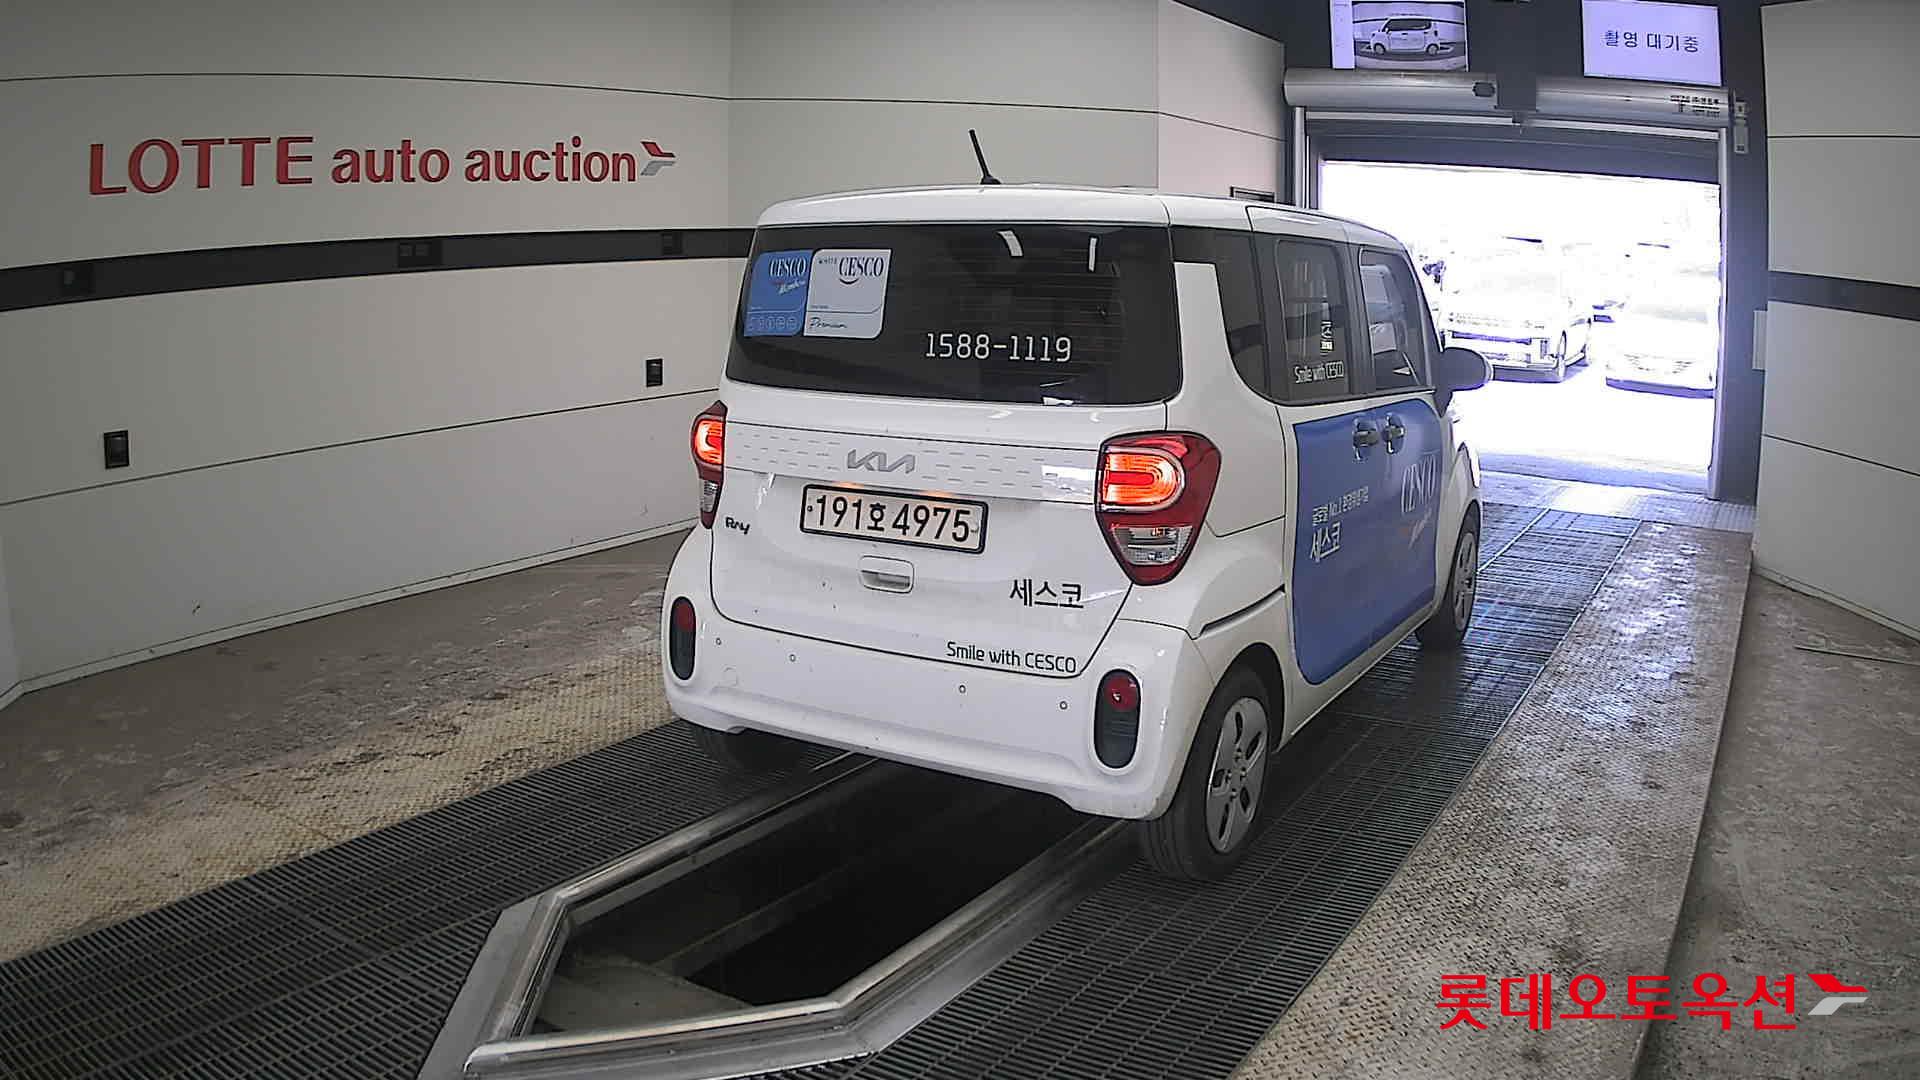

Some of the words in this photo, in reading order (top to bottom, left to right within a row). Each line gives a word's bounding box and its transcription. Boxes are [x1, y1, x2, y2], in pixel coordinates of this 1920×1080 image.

[1646, 33, 1699, 53] 대기중
[88, 135, 314, 195] LOTTE
[330, 139, 451, 185] auto
[464, 134, 637, 184] auction
[769, 257, 808, 278] CESCO
[839, 256, 885, 277] CESCO
[925, 332, 1073, 363] 1588-1119
[1310, 521, 1341, 562] 세스코
[1009, 578, 1084, 609] 세스코
[946, 641, 985, 662] Smile
[989, 648, 1021, 667] with
[1025, 652, 1077, 674] CESCO
